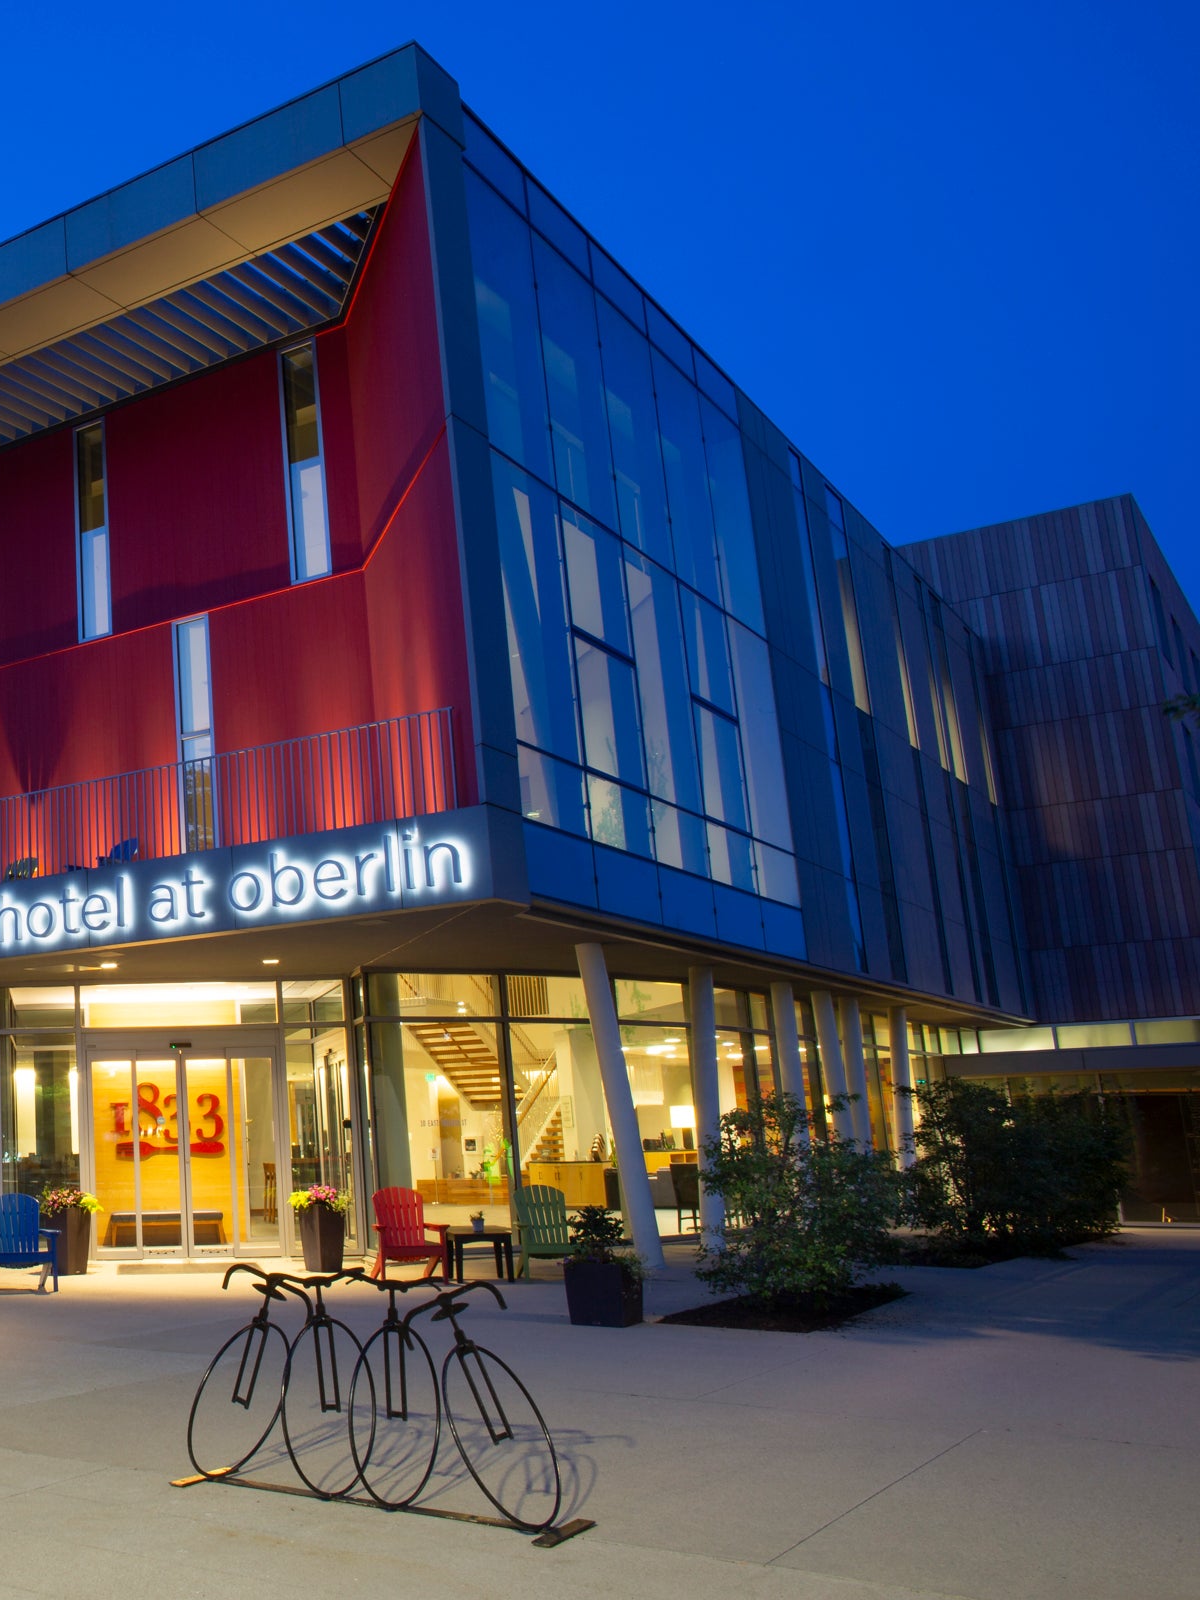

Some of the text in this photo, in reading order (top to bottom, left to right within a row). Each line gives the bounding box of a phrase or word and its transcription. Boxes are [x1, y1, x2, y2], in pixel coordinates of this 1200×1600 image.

[149, 869, 208, 921] at
[230, 832, 463, 912] oberlin
[110, 1081, 224, 1142] 1833
